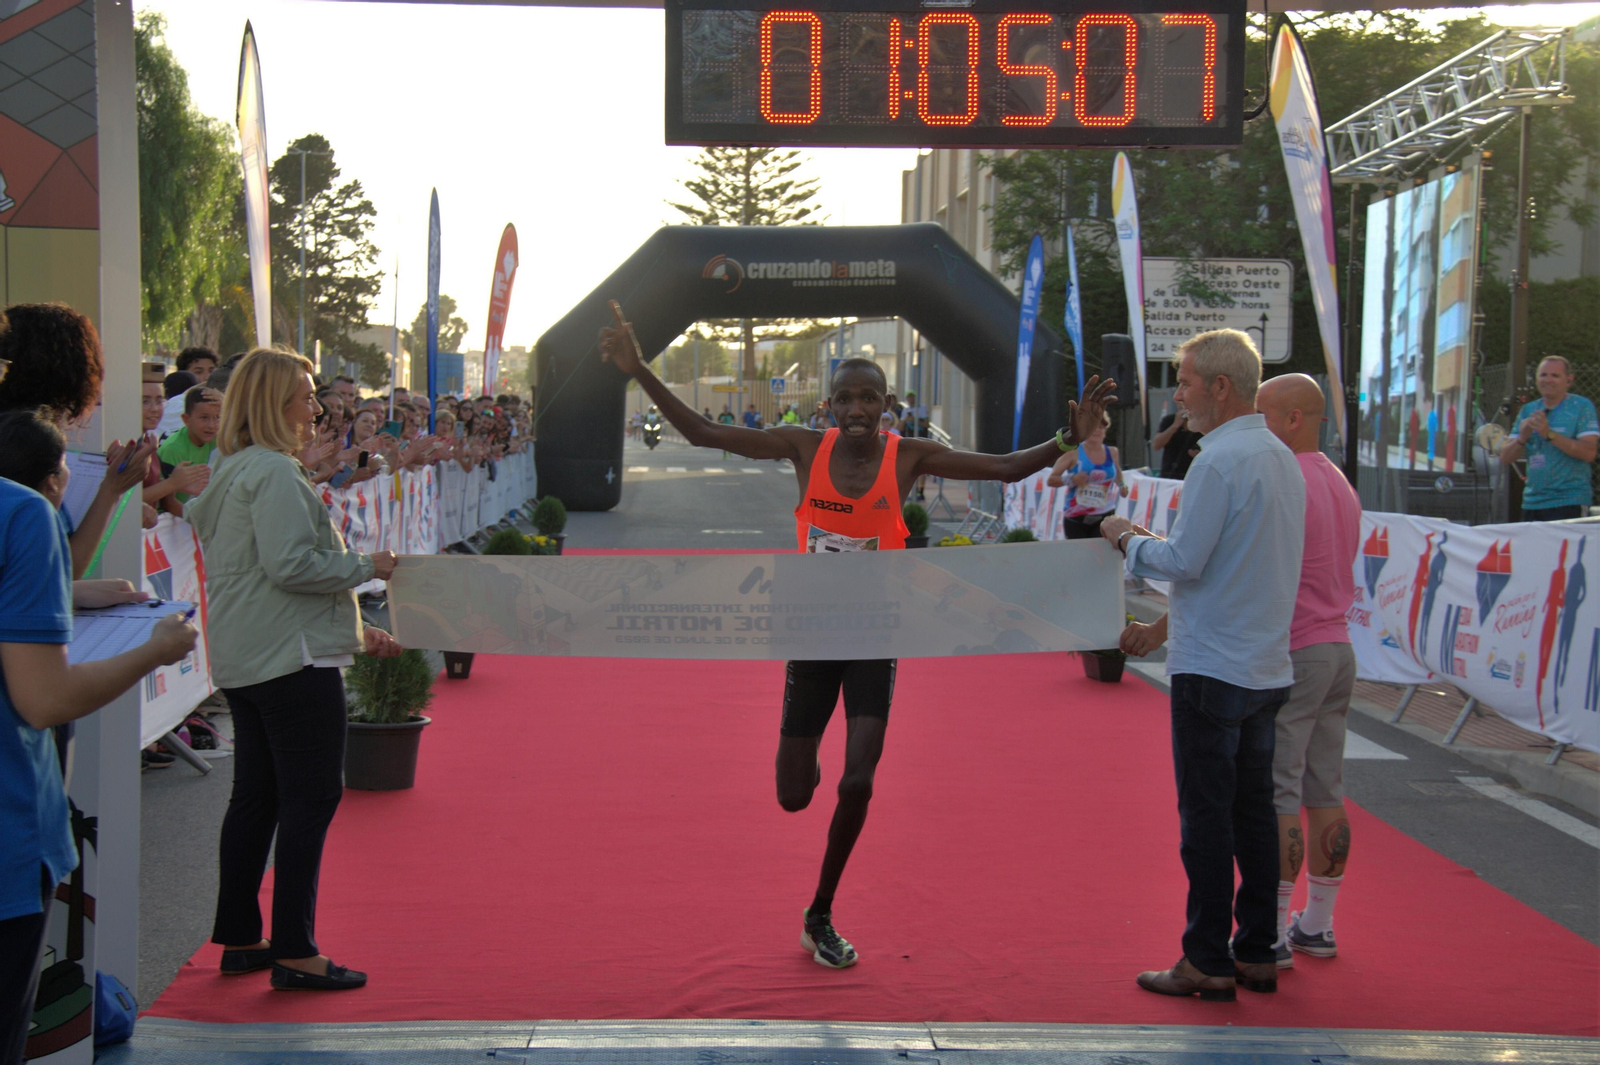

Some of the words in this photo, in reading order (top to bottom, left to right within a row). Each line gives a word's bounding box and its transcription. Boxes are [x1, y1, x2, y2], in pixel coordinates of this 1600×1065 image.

[1236, 265, 1279, 276] Puerto
[1243, 279, 1280, 289] Oeste
[1153, 288, 1166, 297] de
[1144, 299, 1157, 308] de
[1163, 299, 1187, 308] 8:00
[1241, 300, 1271, 309] horas
[1144, 310, 1180, 321] Salida
[1184, 311, 1226, 322] Puerto
[1145, 325, 1191, 336] Acceso
[1151, 343, 1165, 352] 24
